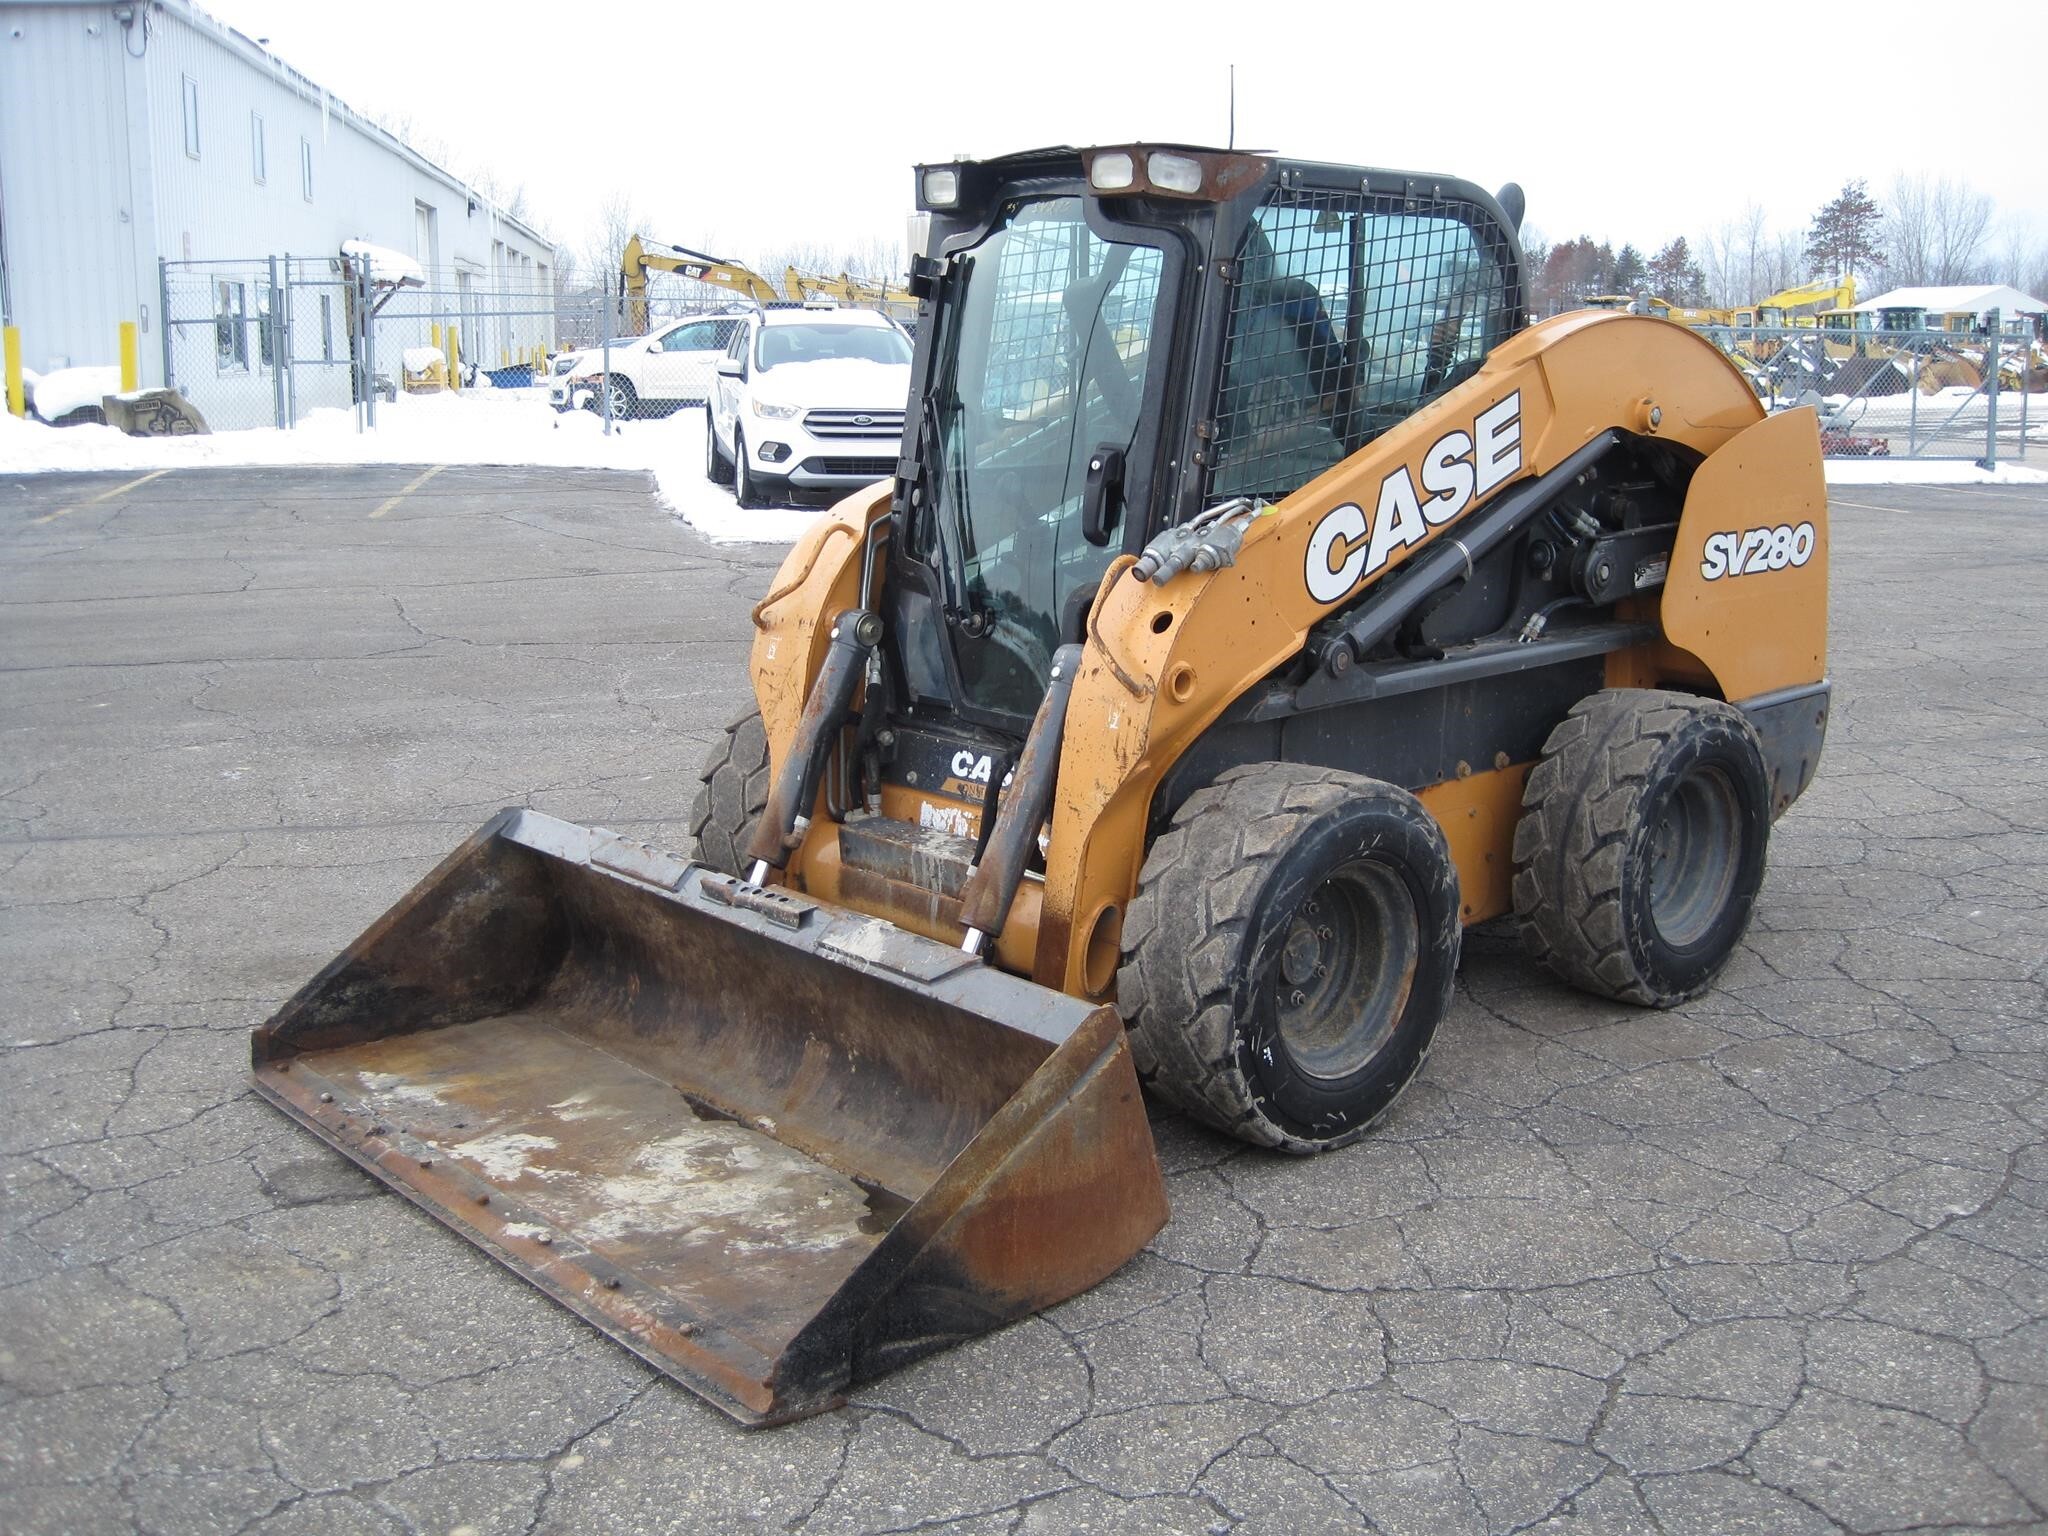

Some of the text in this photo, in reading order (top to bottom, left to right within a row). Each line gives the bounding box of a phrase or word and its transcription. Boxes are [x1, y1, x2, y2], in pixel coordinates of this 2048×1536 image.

[685, 265, 702, 278] CAT
[1304, 388, 1522, 604] CASE
[1700, 521, 1815, 581] SV280
